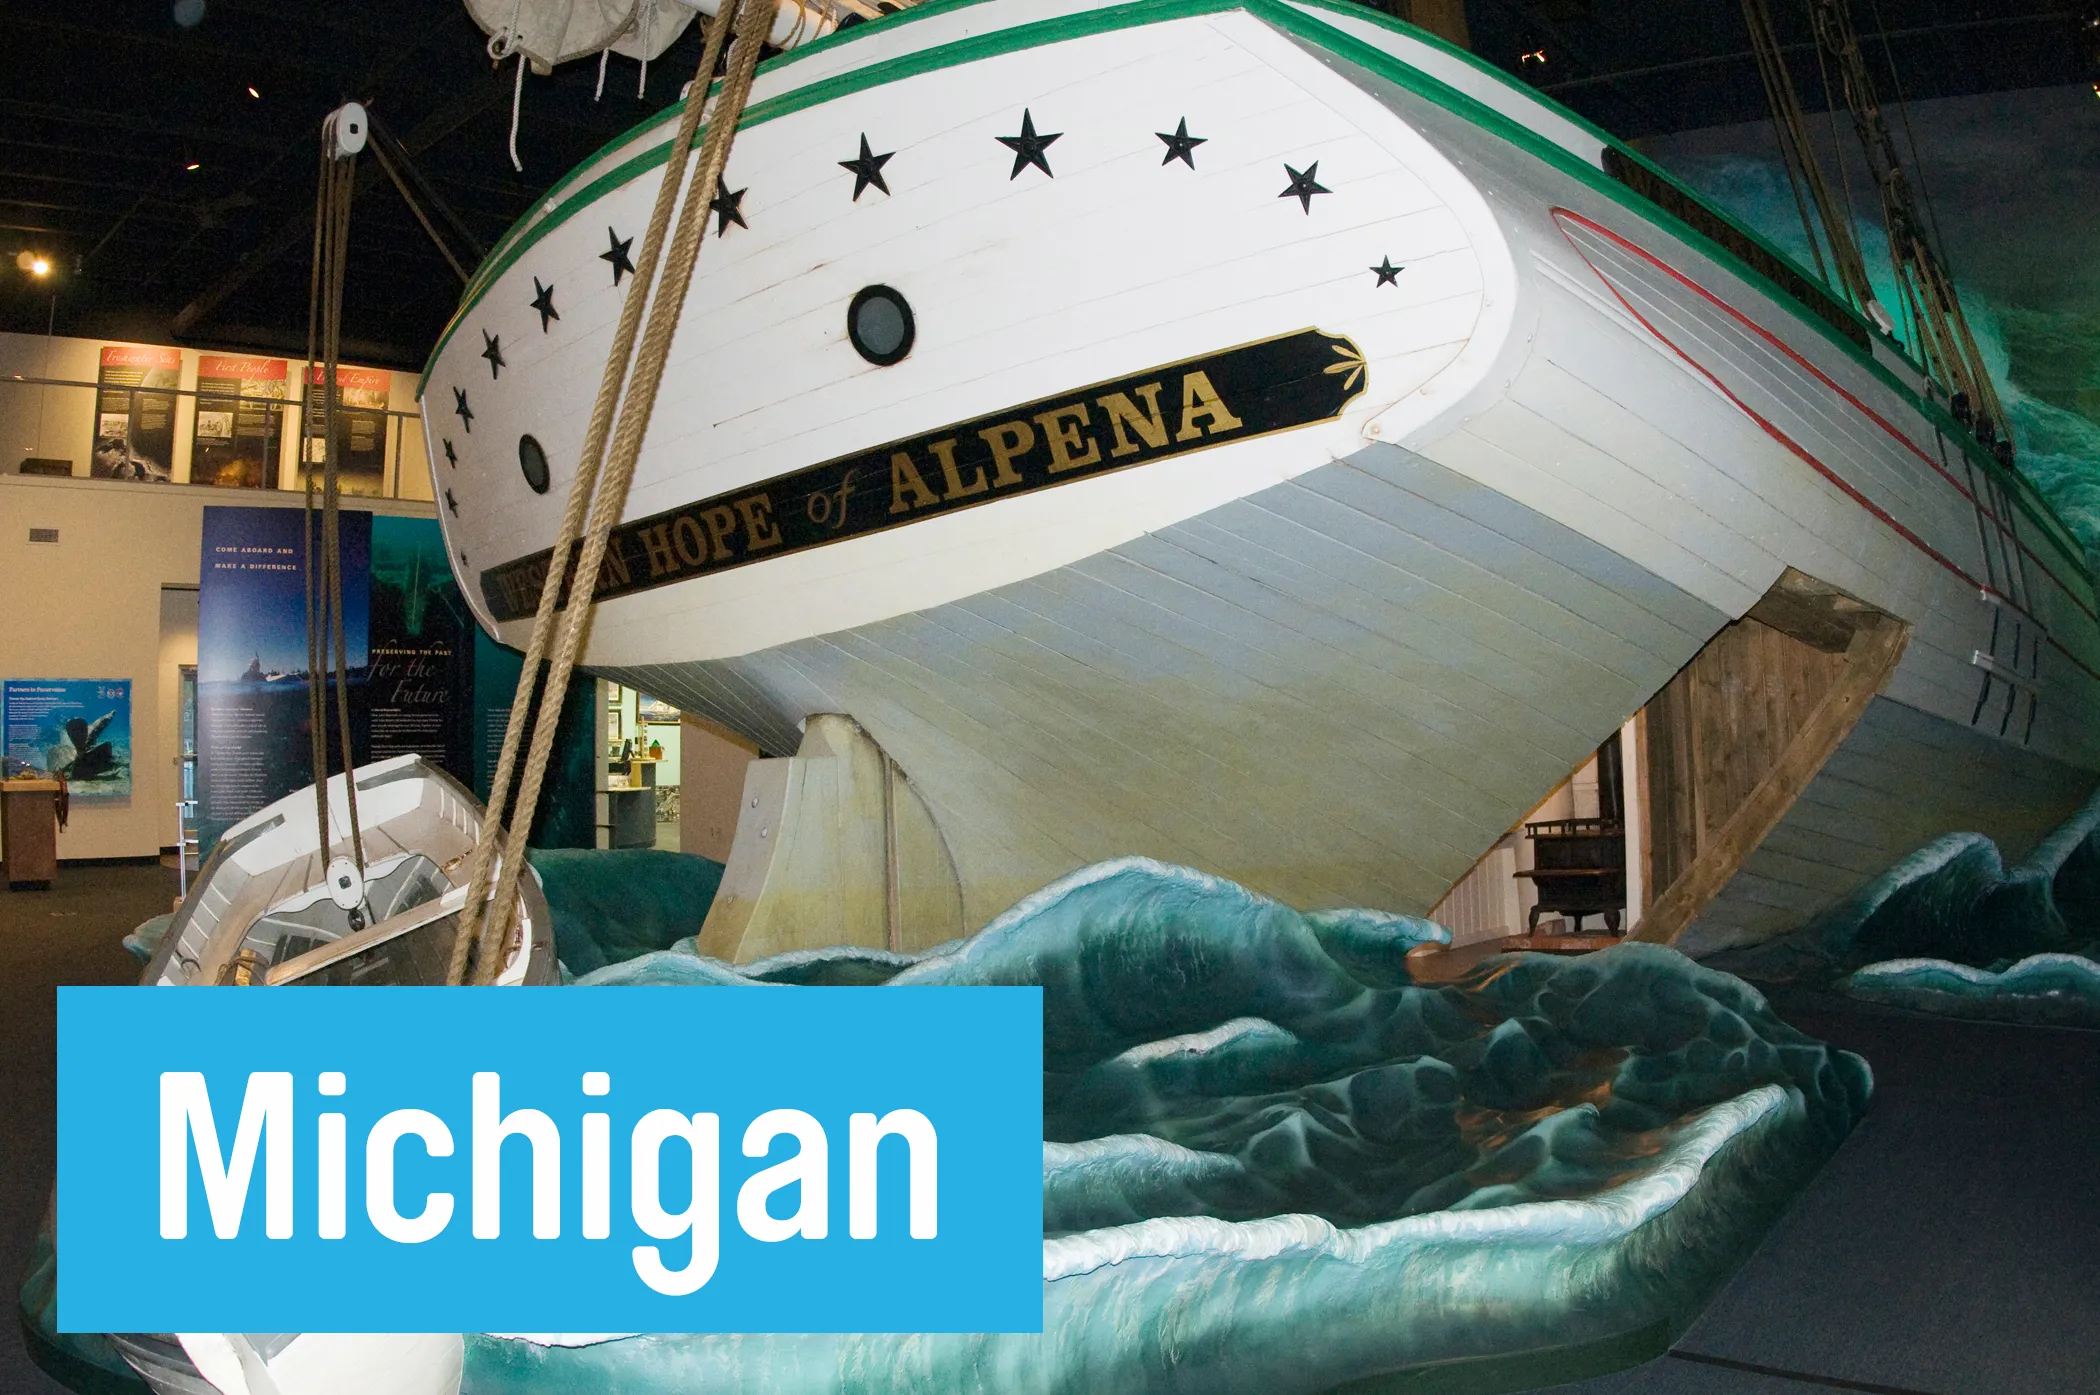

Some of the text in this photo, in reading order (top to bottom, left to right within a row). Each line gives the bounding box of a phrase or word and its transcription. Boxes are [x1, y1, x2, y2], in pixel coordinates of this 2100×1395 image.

[106, 350, 176, 365] Freshwater Seas
[215, 359, 271, 381] First People
[350, 371, 381, 391] Empire
[637, 493, 782, 577] HOPE
[806, 468, 857, 529] of
[888, 370, 1242, 515] ALPENA
[366, 639, 444, 681] for the
[390, 678, 449, 704] Future
